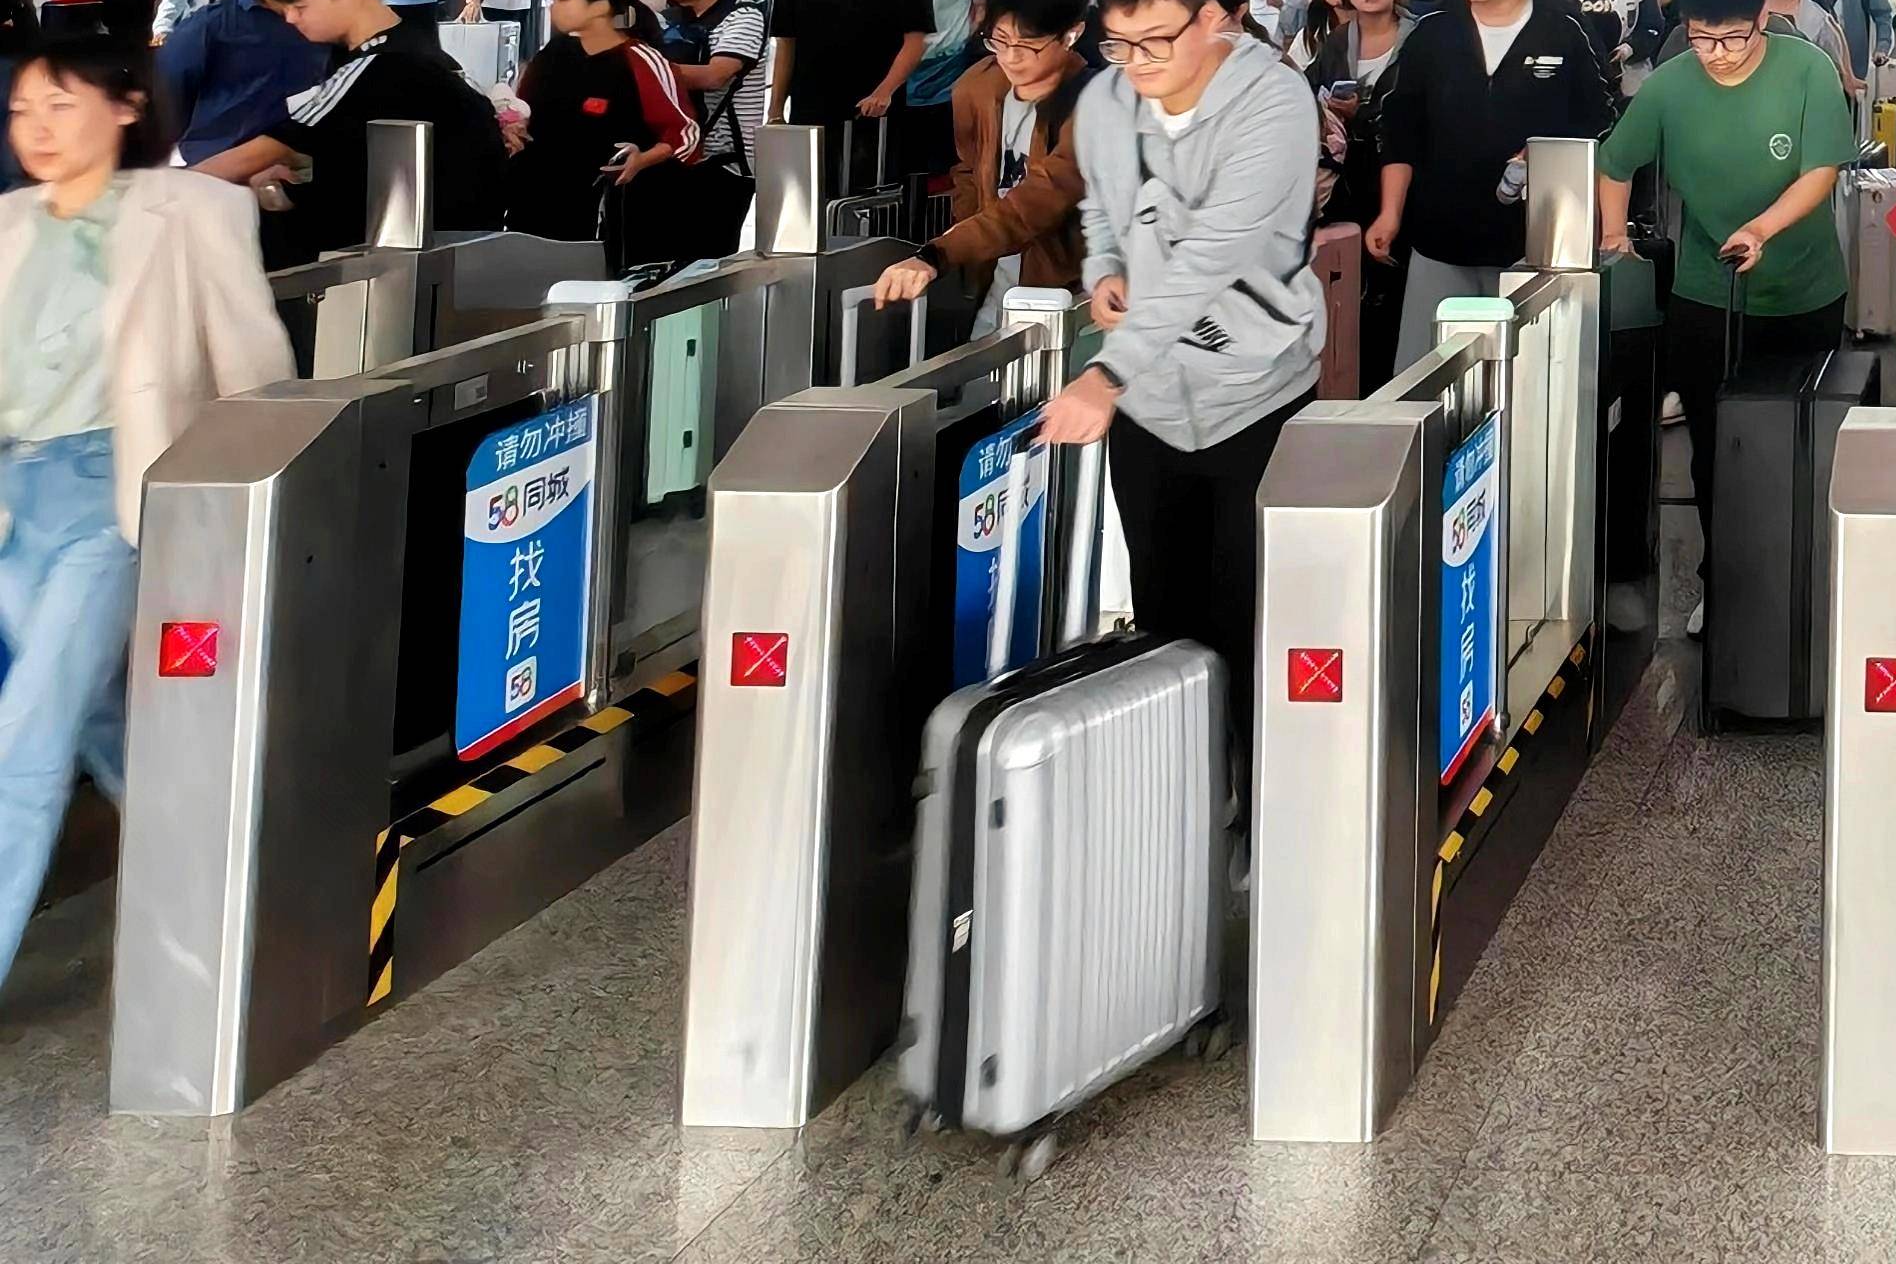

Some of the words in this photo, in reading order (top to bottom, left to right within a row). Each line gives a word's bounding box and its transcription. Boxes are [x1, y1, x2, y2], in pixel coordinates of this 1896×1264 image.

[488, 465, 569, 530] 58同城
[507, 539, 544, 661] 找房
[510, 666, 532, 702] 58
